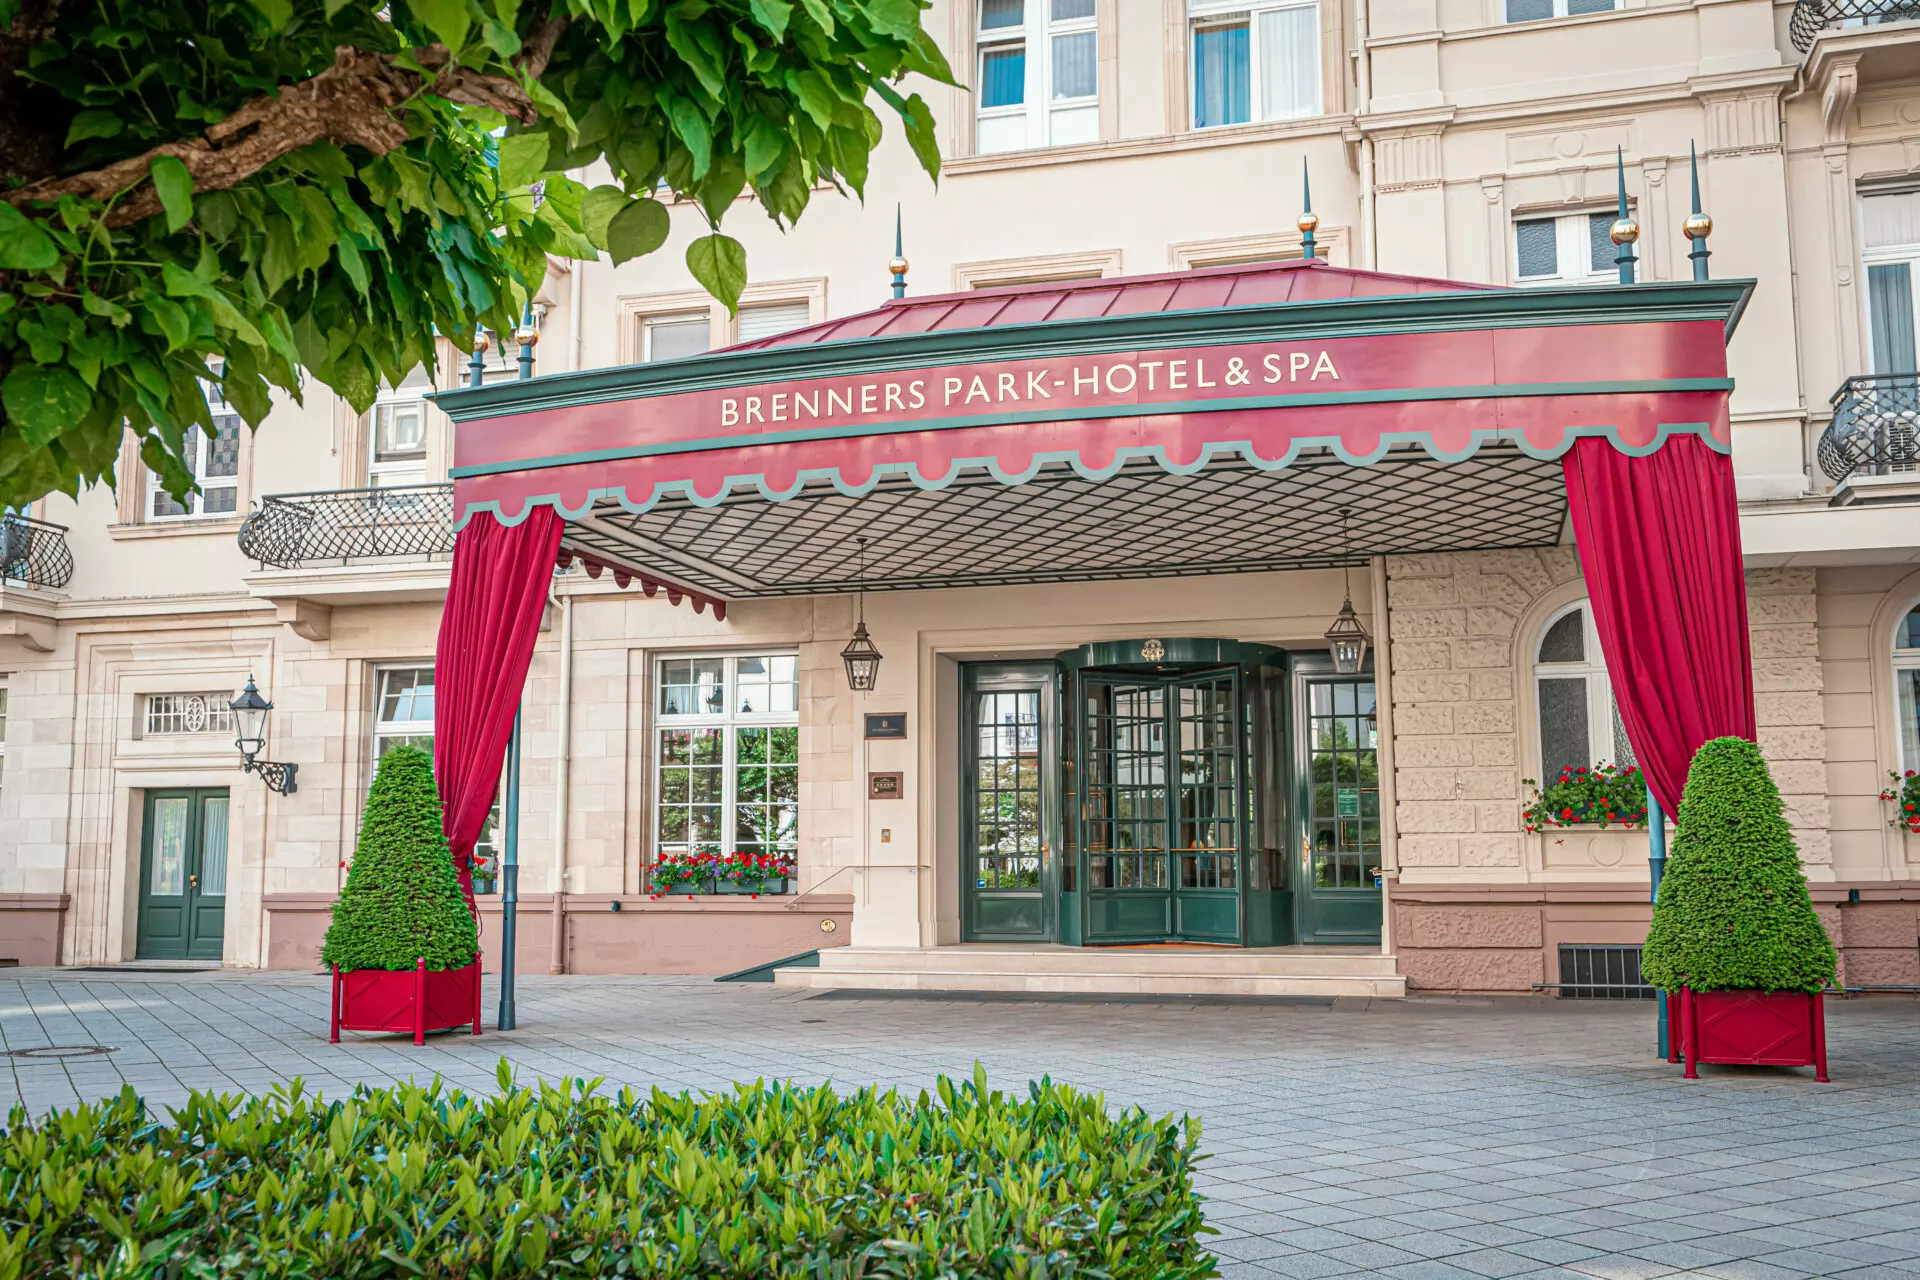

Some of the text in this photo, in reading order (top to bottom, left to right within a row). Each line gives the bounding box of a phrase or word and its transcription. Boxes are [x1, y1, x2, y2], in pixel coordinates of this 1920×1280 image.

[721, 350, 1340, 427] BRENNERS PARK-HOTEL & SPA
